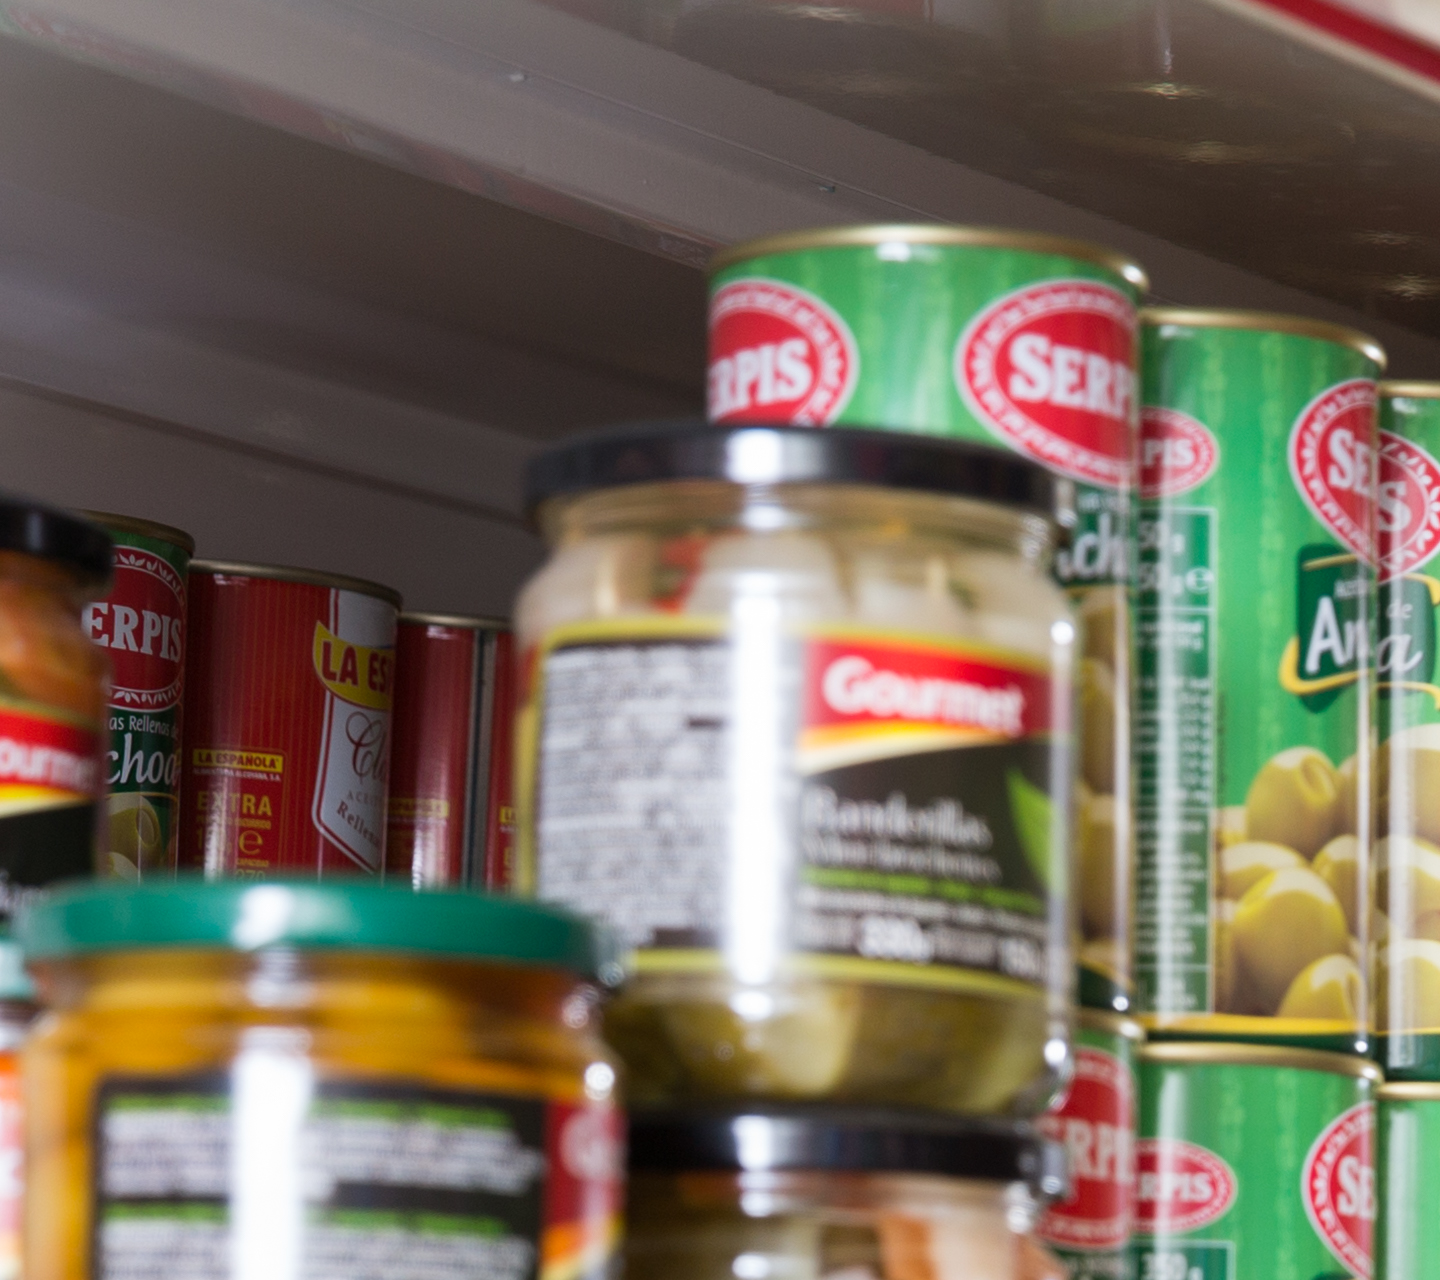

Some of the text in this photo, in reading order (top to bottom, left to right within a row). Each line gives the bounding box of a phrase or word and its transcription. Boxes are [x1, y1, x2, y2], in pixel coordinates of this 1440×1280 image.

[321, 641, 358, 687] LA
[822, 655, 1024, 738] Gourmet
[215, 752, 278, 771] ESPAÑOLA
